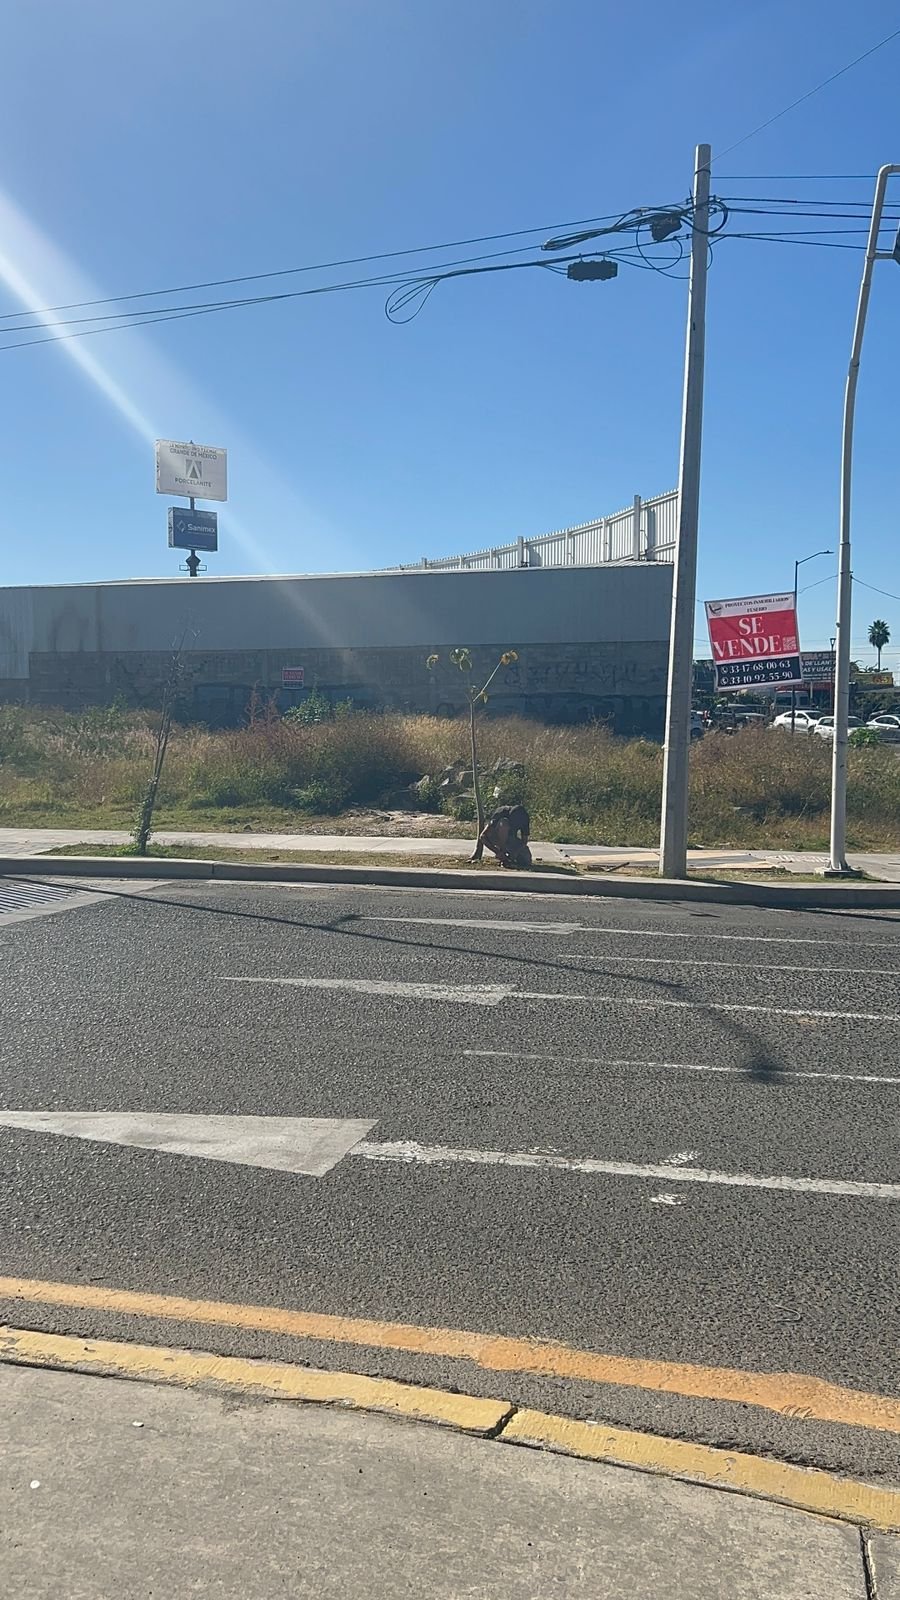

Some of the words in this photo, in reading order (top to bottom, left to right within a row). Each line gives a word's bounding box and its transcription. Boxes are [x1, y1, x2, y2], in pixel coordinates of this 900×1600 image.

[170, 448, 190, 457] GRANDE
[174, 477, 212, 488] PORCELANITE
[187, 523, 216, 534] Sanimex
[725, 600, 753, 609] PROYECTOS
[738, 616, 764, 636] SE
[713, 634, 782, 658] VENDE
[729, 660, 791, 674] 33-17-68-00-63
[729, 671, 793, 685] 33-10-92-55-90
